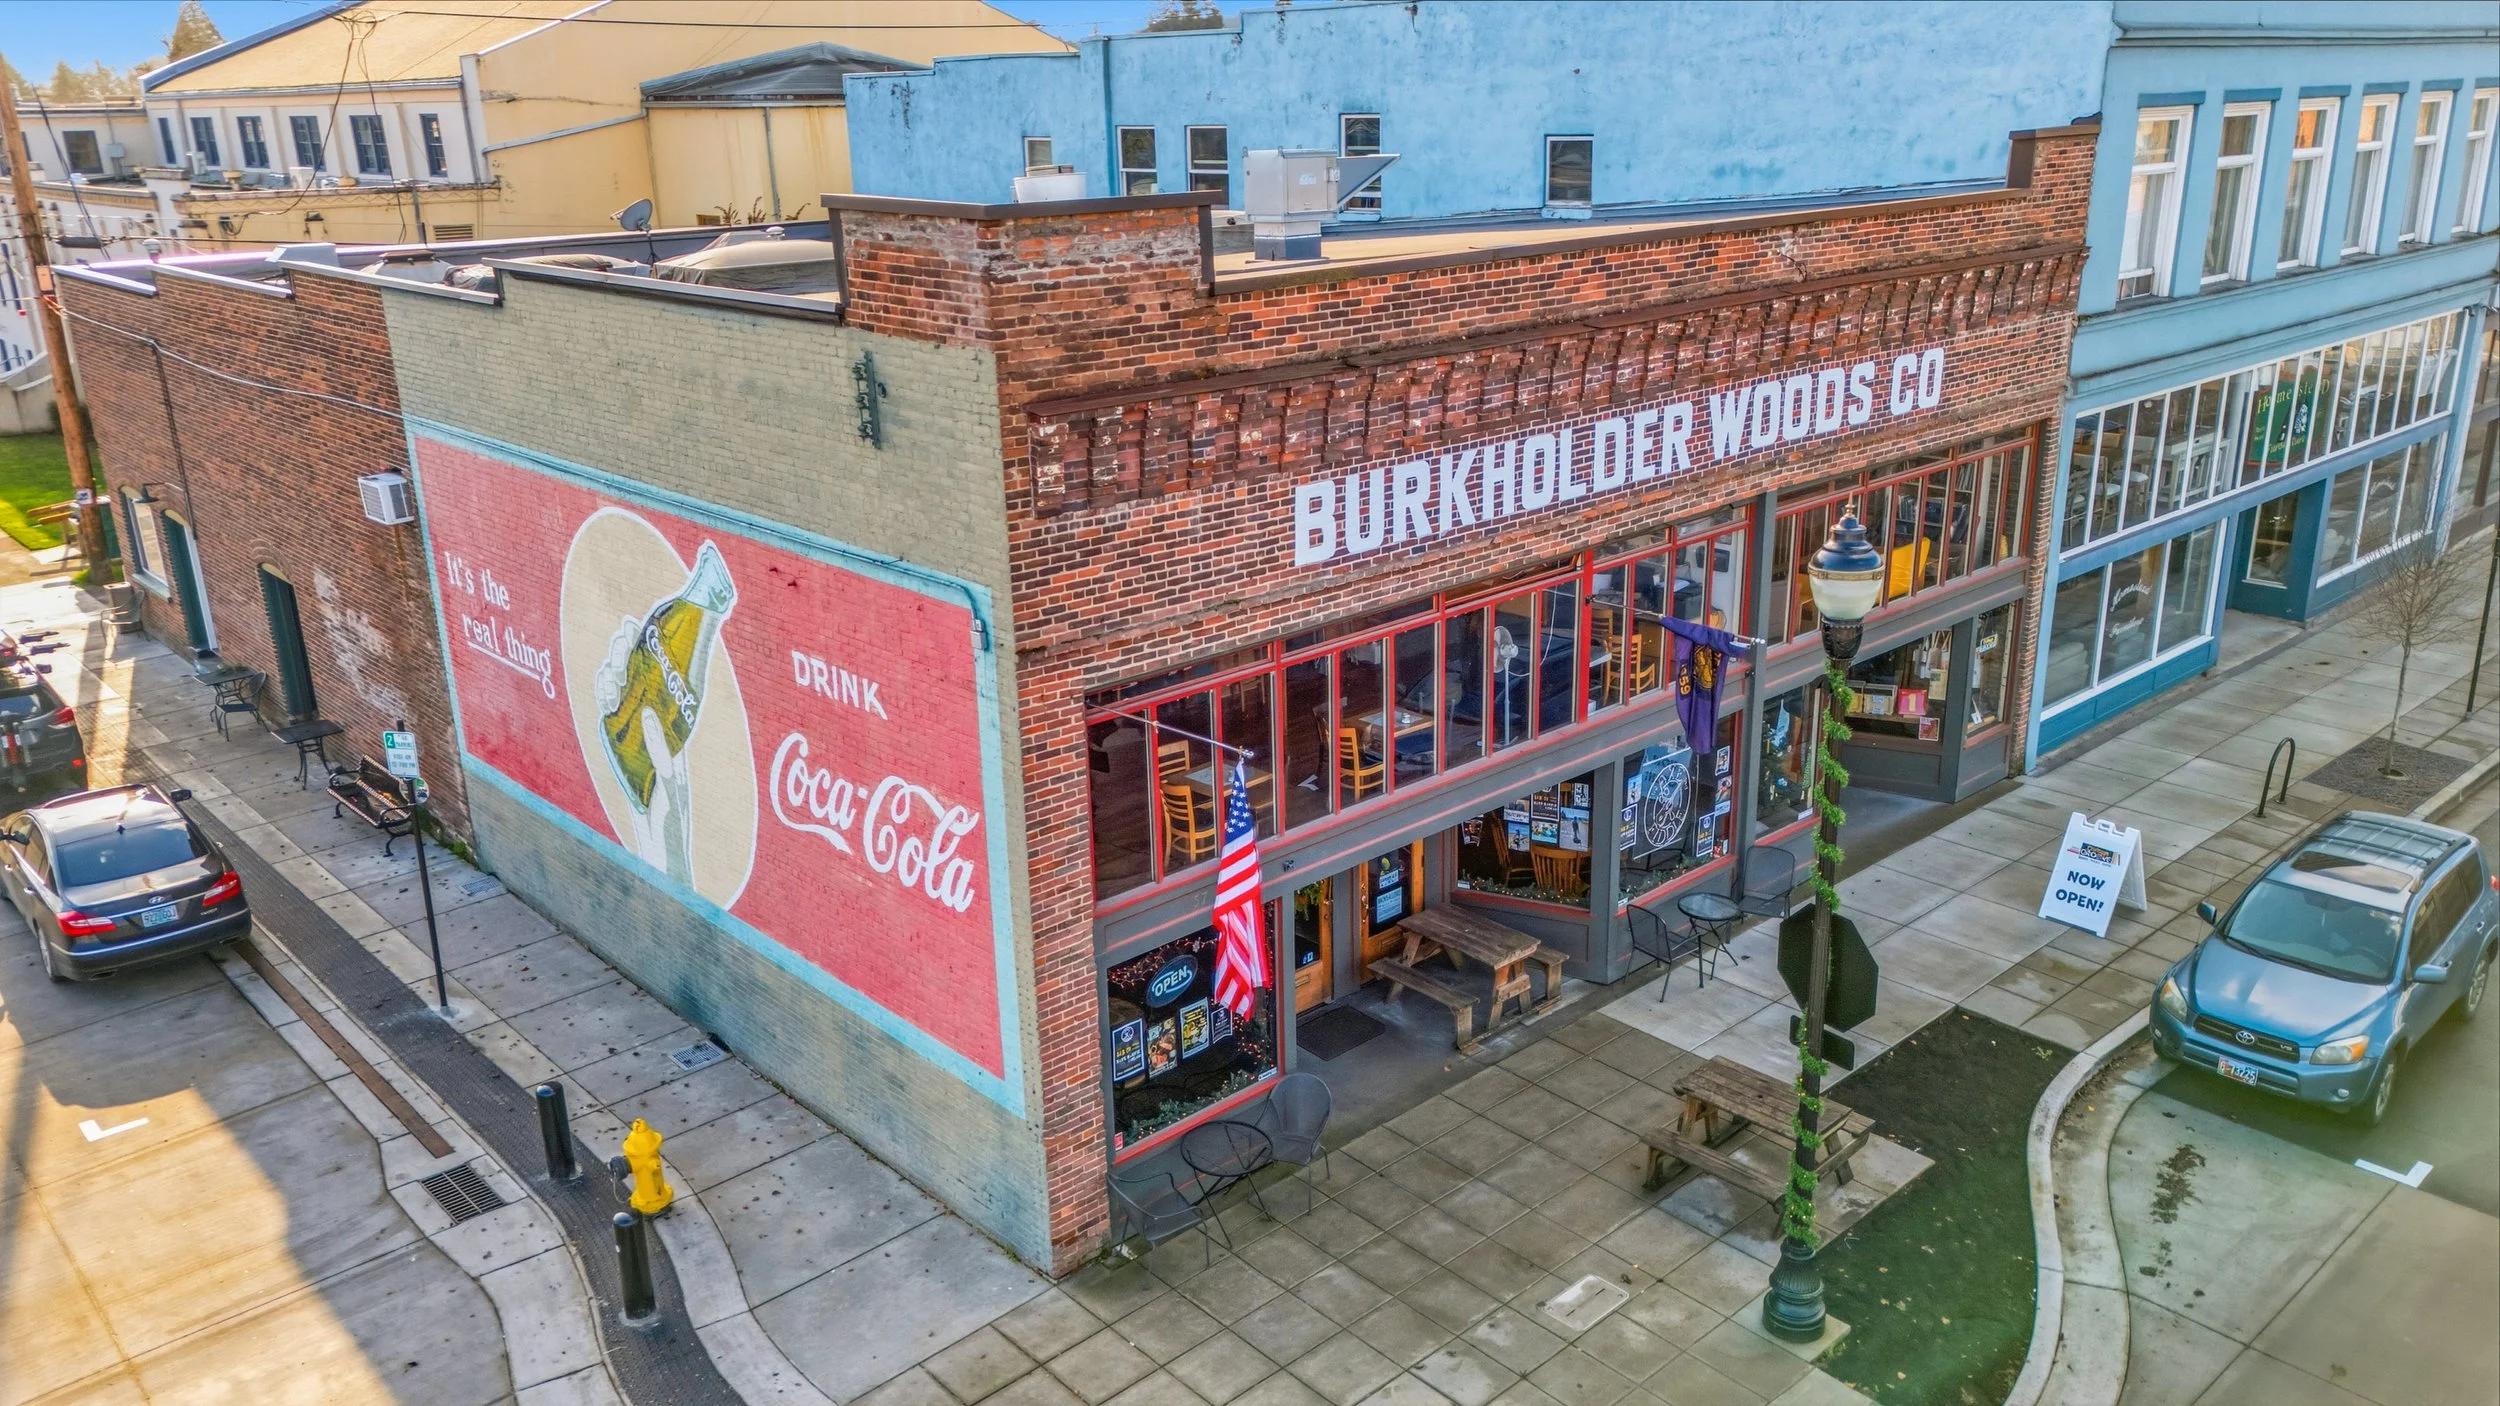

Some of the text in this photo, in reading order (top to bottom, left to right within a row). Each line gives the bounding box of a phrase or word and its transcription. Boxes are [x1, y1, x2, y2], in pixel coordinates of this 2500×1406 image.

[1294, 347, 1945, 567] BURKHOLDER WOODS CO
[444, 551, 511, 611] It's the
[462, 613, 556, 699] real thing
[791, 649, 888, 720] DRINK
[386, 734, 394, 747] 2
[769, 732, 980, 913] Coca-Cola
[2055, 889, 2105, 912] OPEN!
[2067, 870, 2106, 890] NOW
[1153, 965, 1189, 997] OPEN
